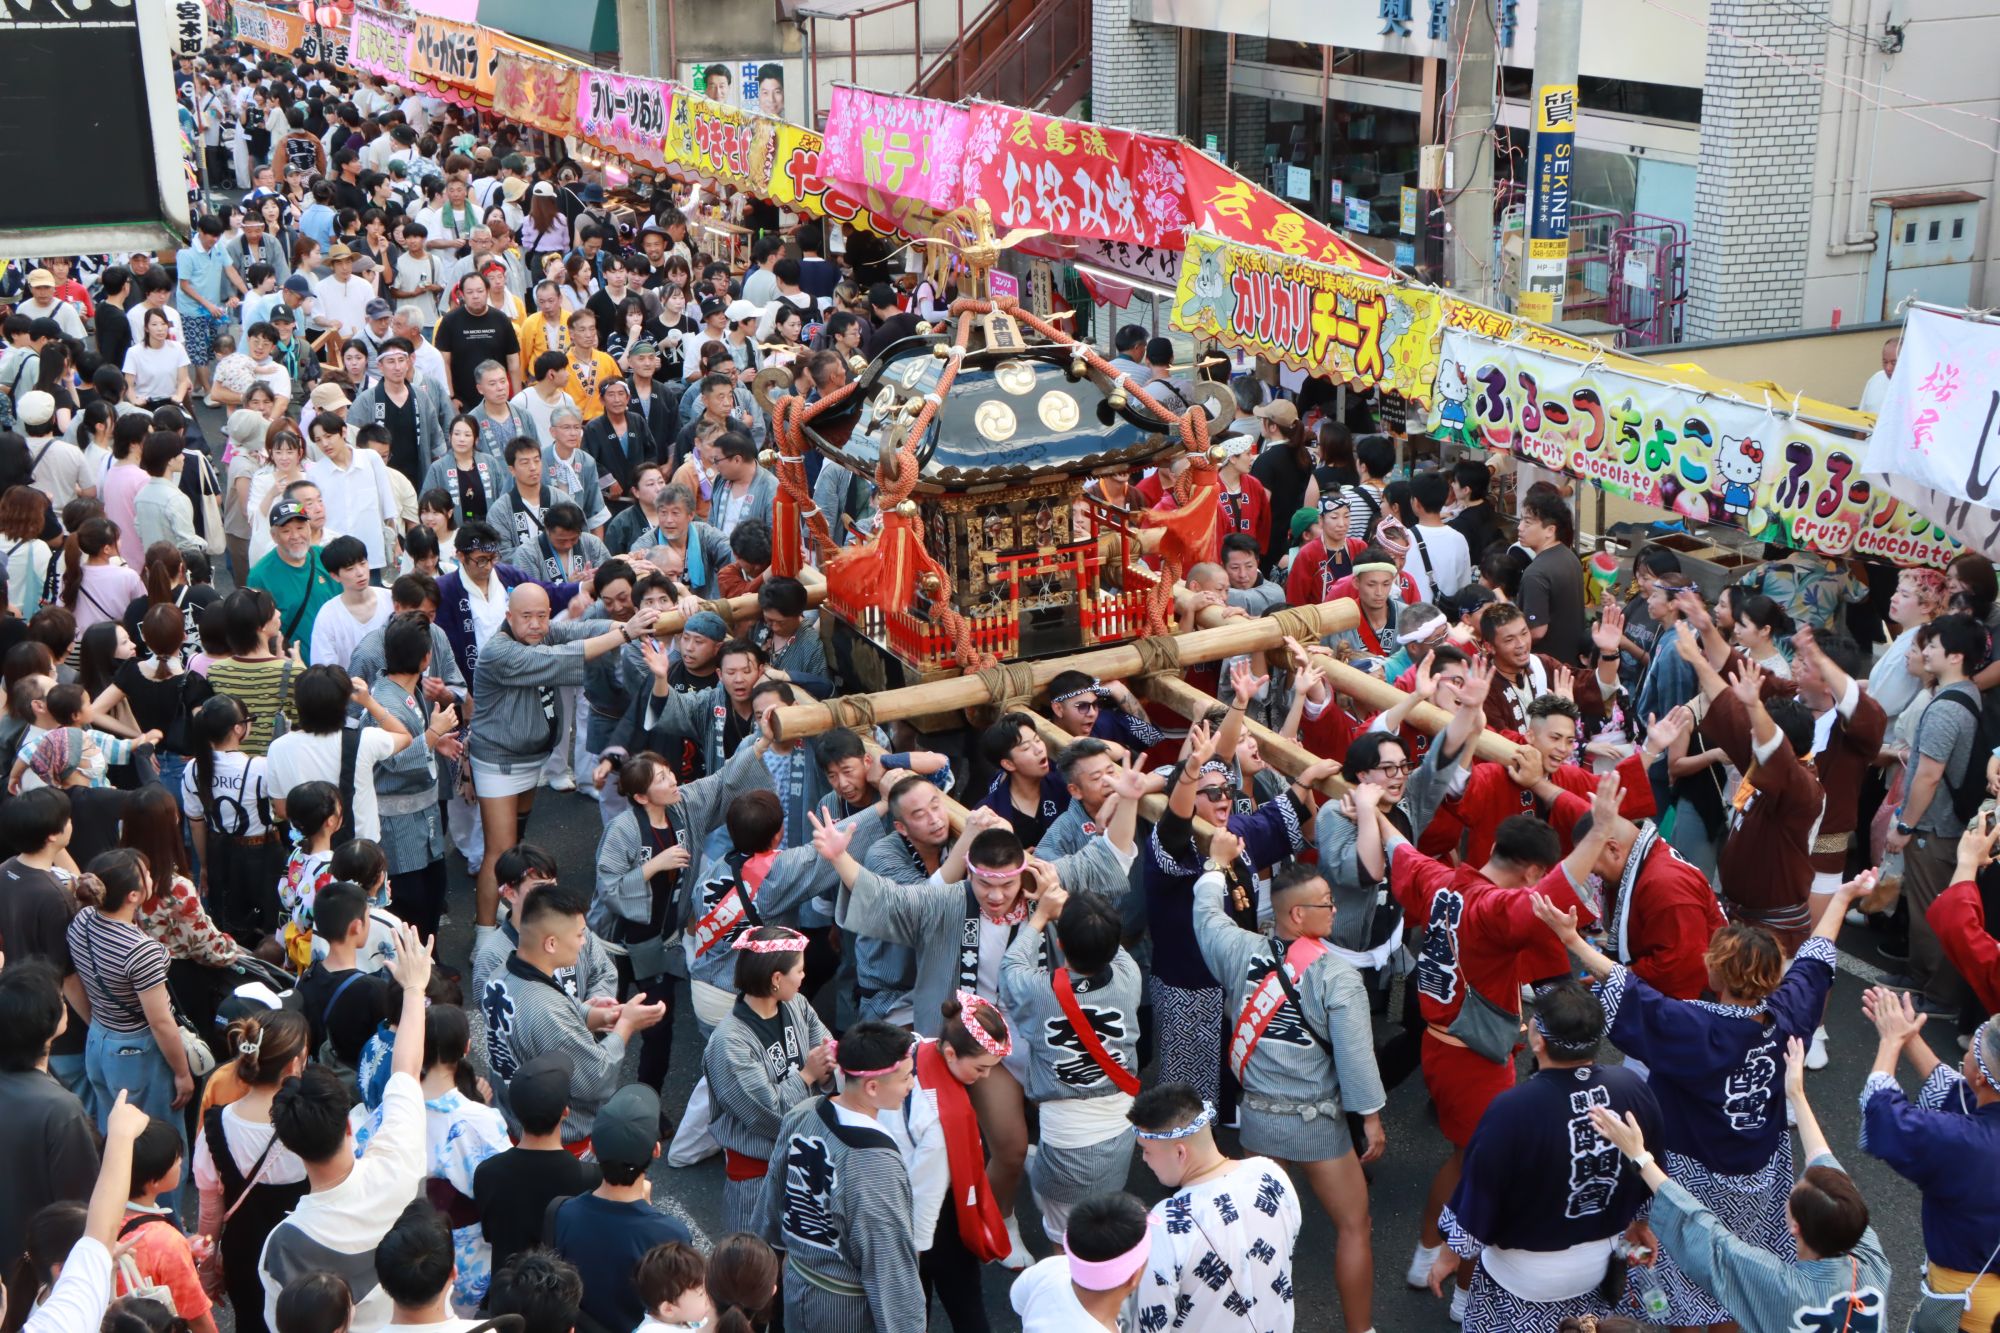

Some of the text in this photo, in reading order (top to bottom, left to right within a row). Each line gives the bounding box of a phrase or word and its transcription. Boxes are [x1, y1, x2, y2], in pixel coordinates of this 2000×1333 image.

[176, 1, 203, 52] 宮本町
[742, 63, 759, 99] 中根
[590, 77, 666, 136] フルーツあめ
[860, 95, 938, 131] シャカシャカ
[1544, 90, 1574, 127] 質
[1006, 114, 1120, 164] 広島流
[1000, 152, 1146, 242] お好み焼
[1550, 143, 1571, 229] SEKINE
[1230, 270, 1312, 356] カリカリ
[1311, 289, 1387, 381] チーズ
[1475, 364, 1713, 485] ふるーつちょこ
[1523, 435, 1565, 466] Fruit
[1794, 516, 1849, 545] Fruit
[211, 774, 244, 790] DRIĆ
